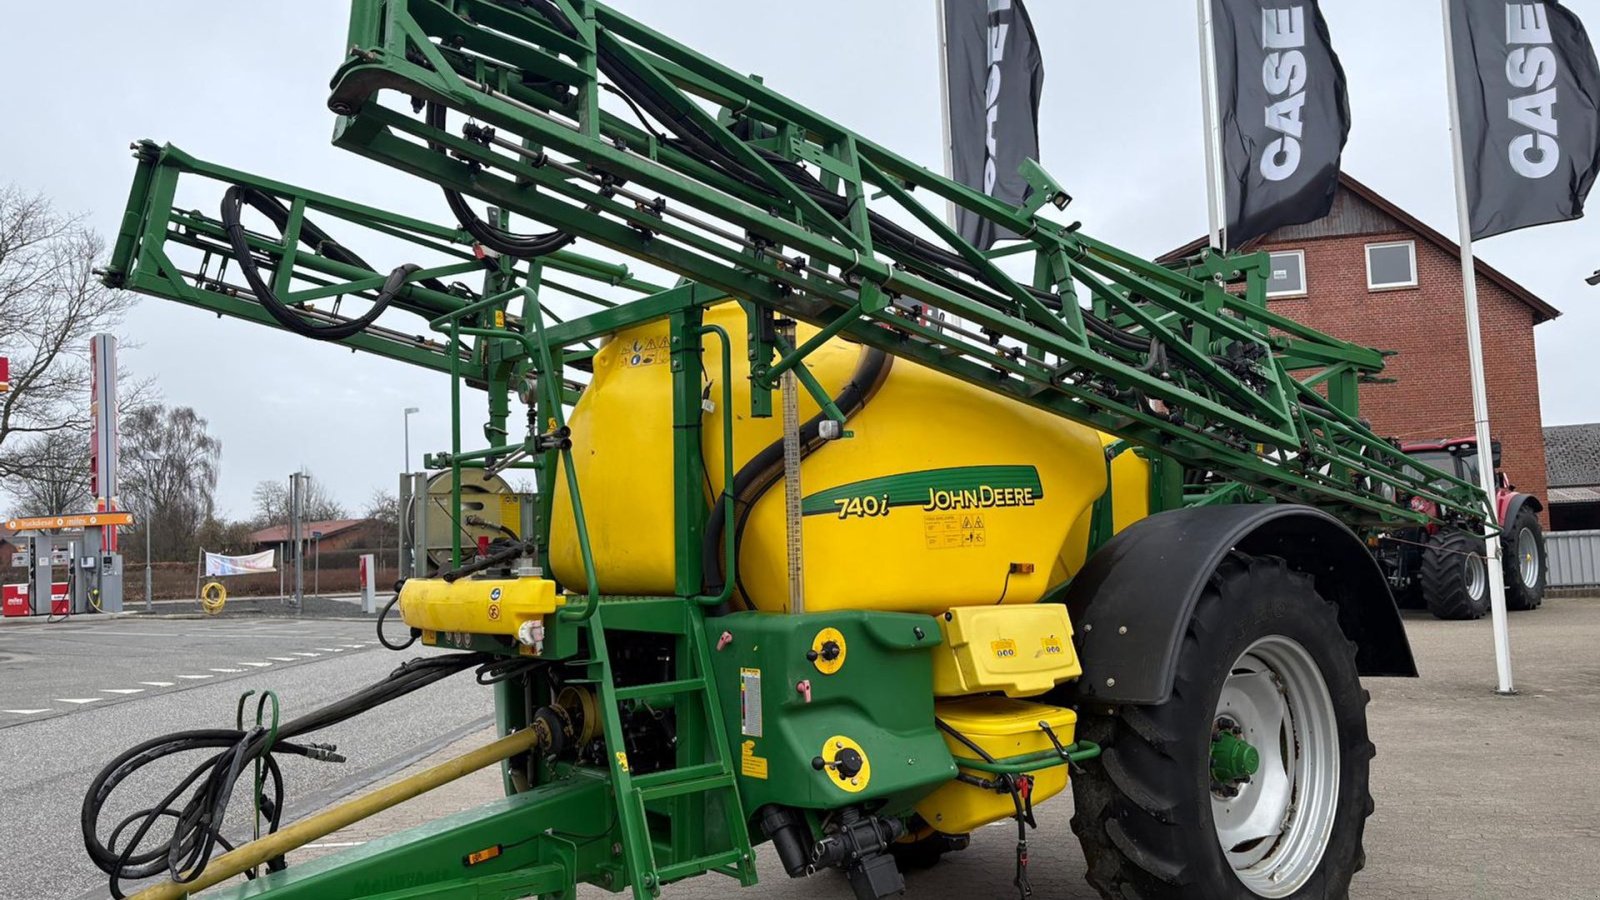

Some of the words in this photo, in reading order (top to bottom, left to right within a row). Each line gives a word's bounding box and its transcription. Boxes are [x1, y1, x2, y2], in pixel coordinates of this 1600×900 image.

[1260, 5, 1307, 181] CASE
[1505, 2, 1560, 179] CASE
[834, 493, 890, 519] 740i
[923, 487, 978, 511] JOHN
[979, 485, 1034, 507] DEERE
